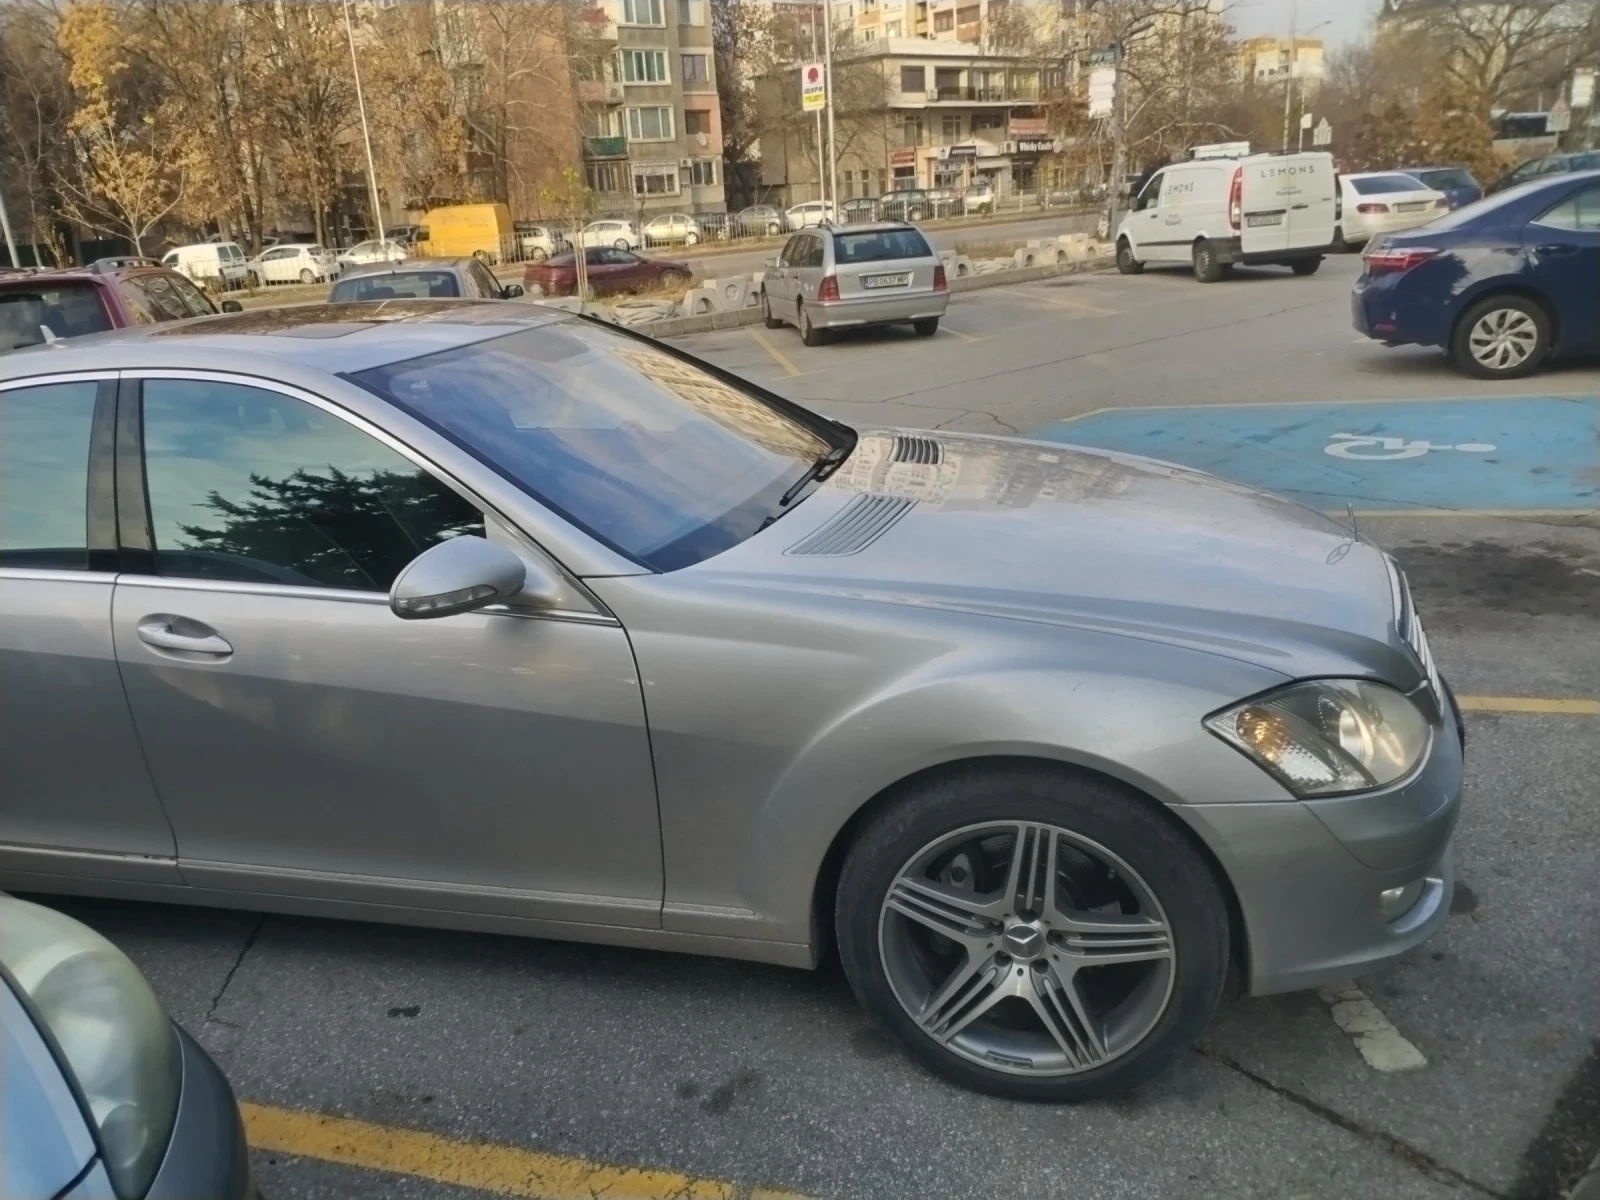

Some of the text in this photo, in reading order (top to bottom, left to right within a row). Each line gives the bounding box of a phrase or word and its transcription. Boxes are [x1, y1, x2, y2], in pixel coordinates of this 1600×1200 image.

[1261, 165, 1315, 178] LEMONS
[868, 278, 878, 286] PB
[880, 276, 896, 285] 0637
